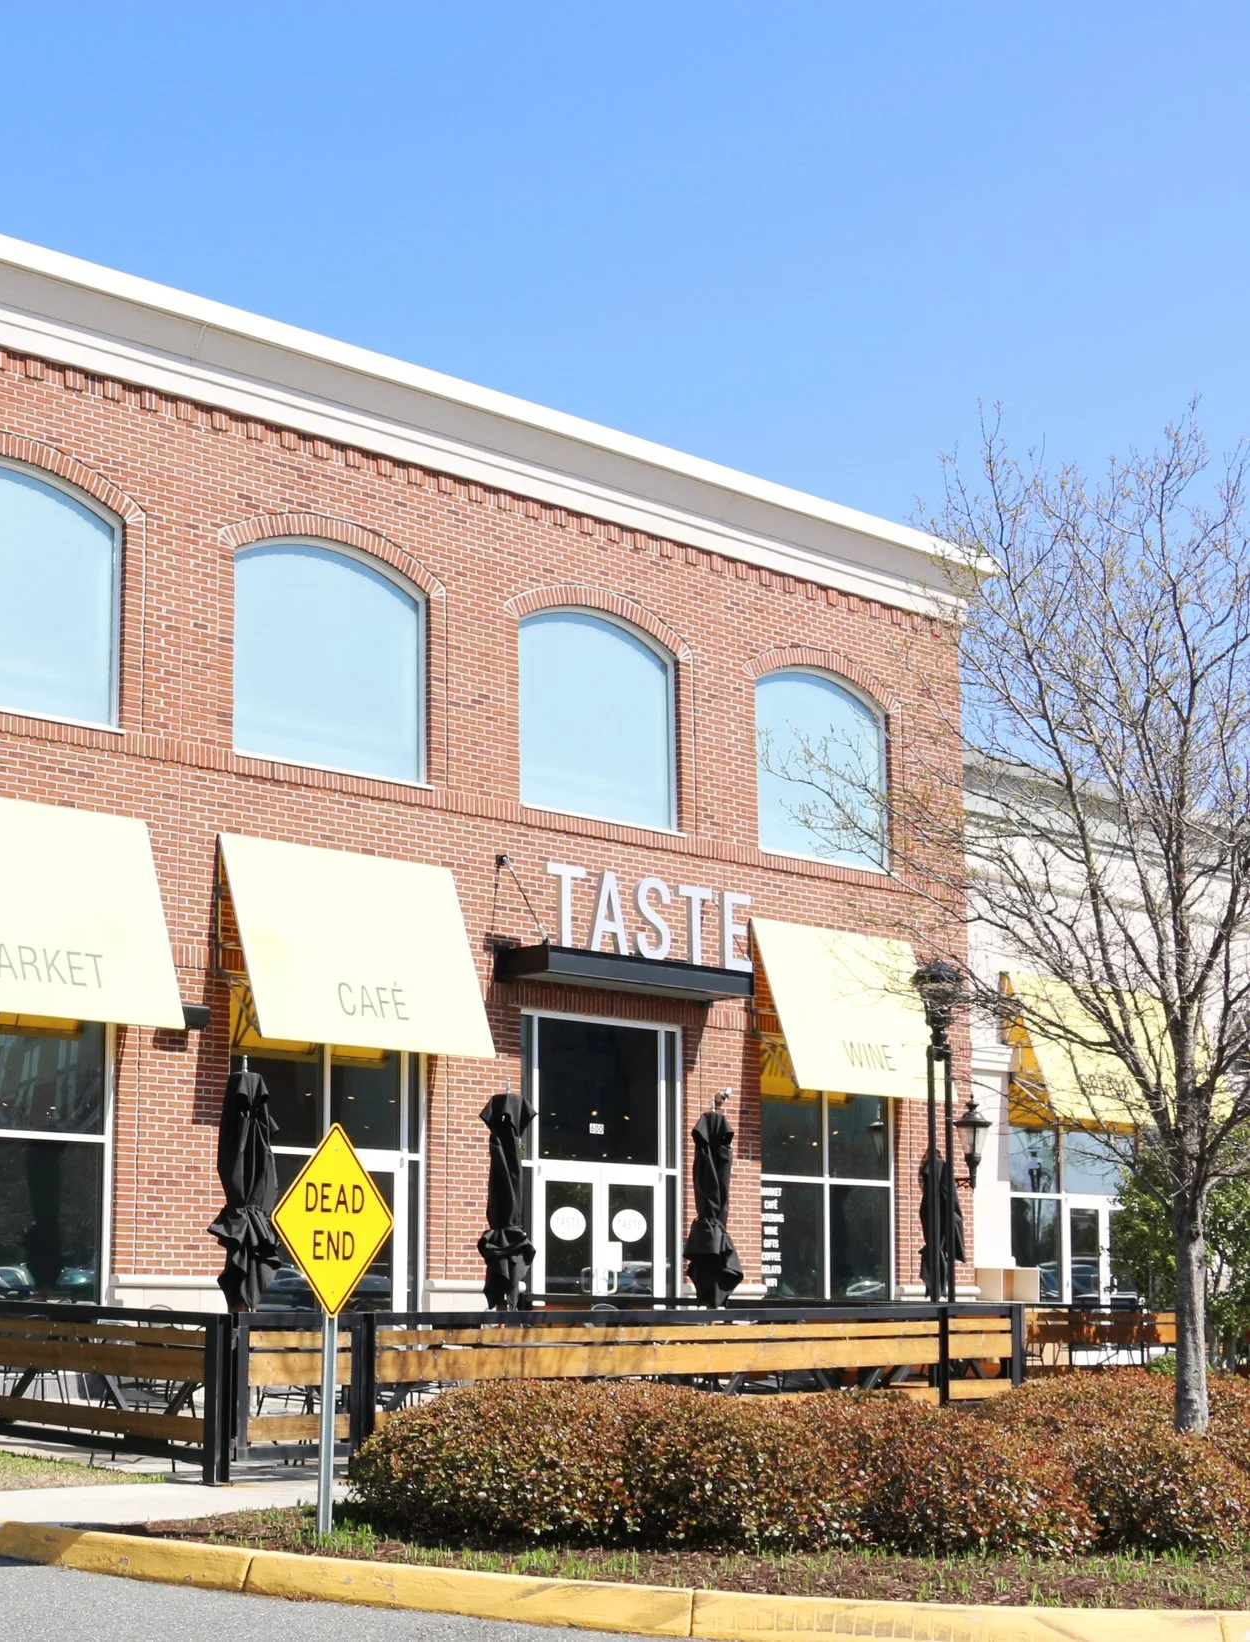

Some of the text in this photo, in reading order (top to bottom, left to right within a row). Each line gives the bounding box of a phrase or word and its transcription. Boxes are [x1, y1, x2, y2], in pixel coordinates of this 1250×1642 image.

[542, 861, 753, 973] TASTE
[337, 981, 411, 1021] CAFÉ
[841, 1039, 897, 1072] WINE
[590, 1124, 604, 1134] 600
[305, 1182, 365, 1214] DEAD
[555, 1216, 581, 1229] TASTE
[617, 1218, 642, 1231] TASTE
[761, 1213, 784, 1223] ATERING
[312, 1230, 355, 1260] END
[763, 1239, 779, 1248] GIFTS
[761, 1252, 782, 1261] COFFEE
[761, 1265, 782, 1274] GELATO
